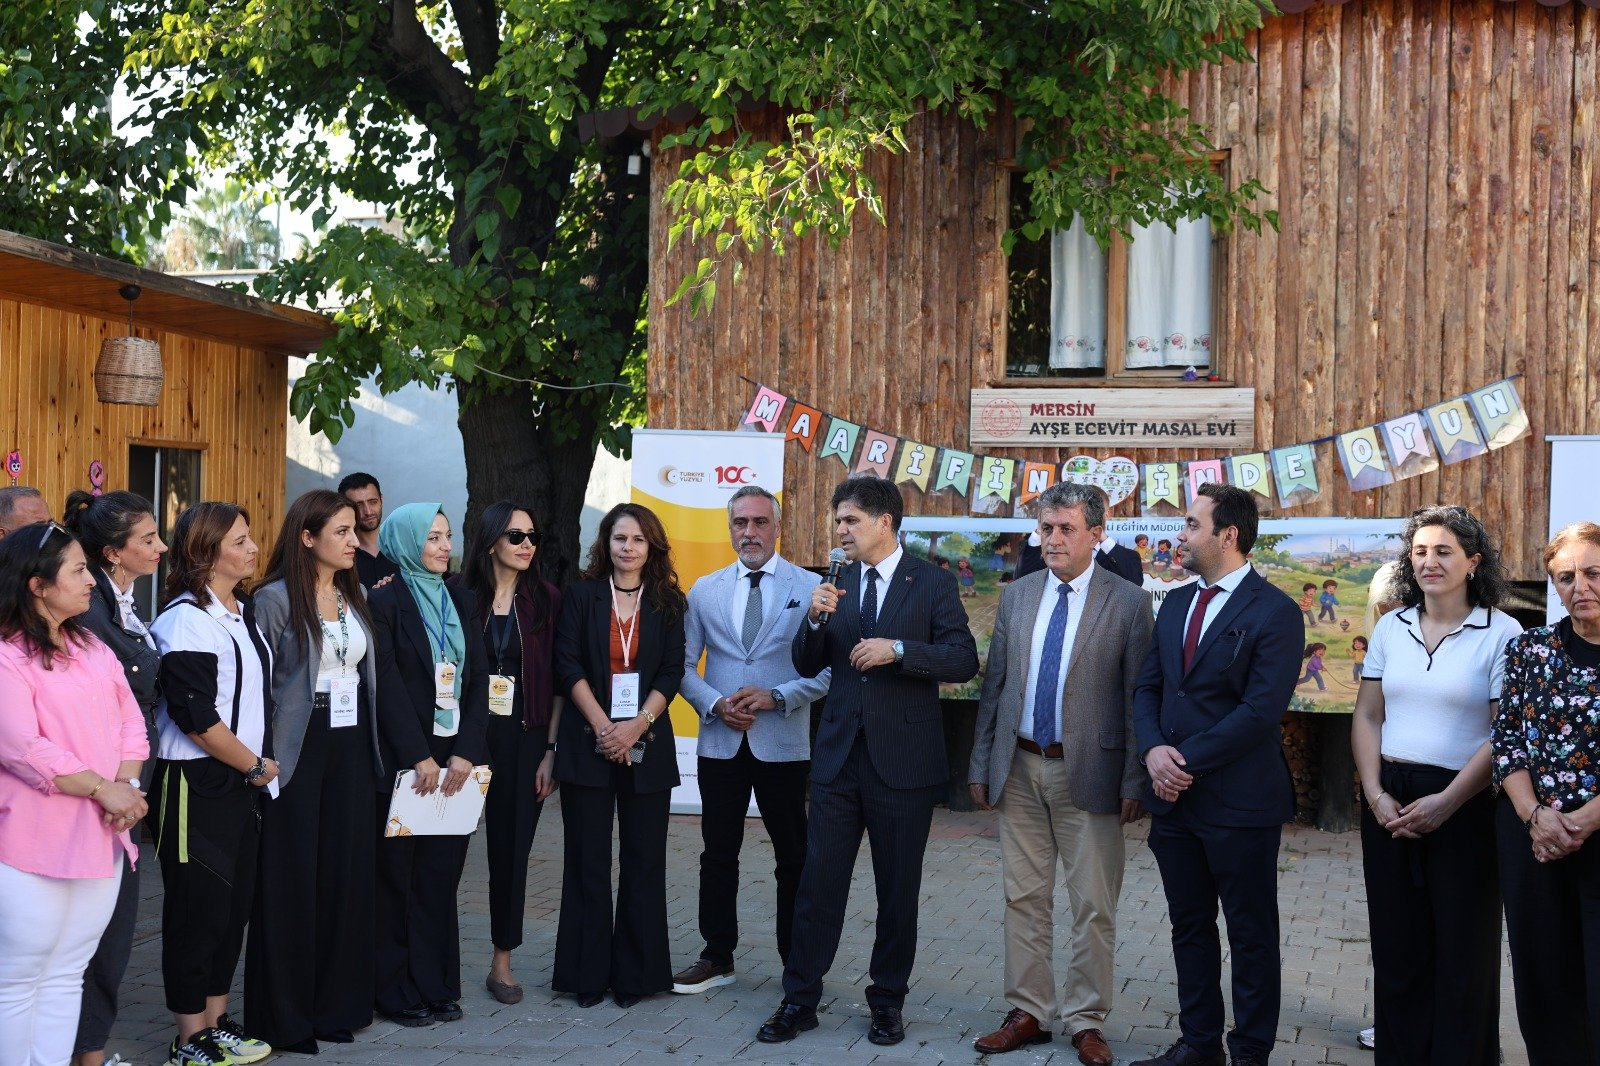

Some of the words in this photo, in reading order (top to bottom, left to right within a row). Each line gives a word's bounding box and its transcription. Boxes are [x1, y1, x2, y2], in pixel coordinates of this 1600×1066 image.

[1029, 400, 1096, 416] MERSİN
[1029, 422, 1070, 438] AYŞE
[1075, 419, 1138, 436] ECEVİT
[1142, 422, 1202, 436] MASAL
[1207, 419, 1237, 436] EVİ
[1116, 522, 1148, 531] EĞİTİM
